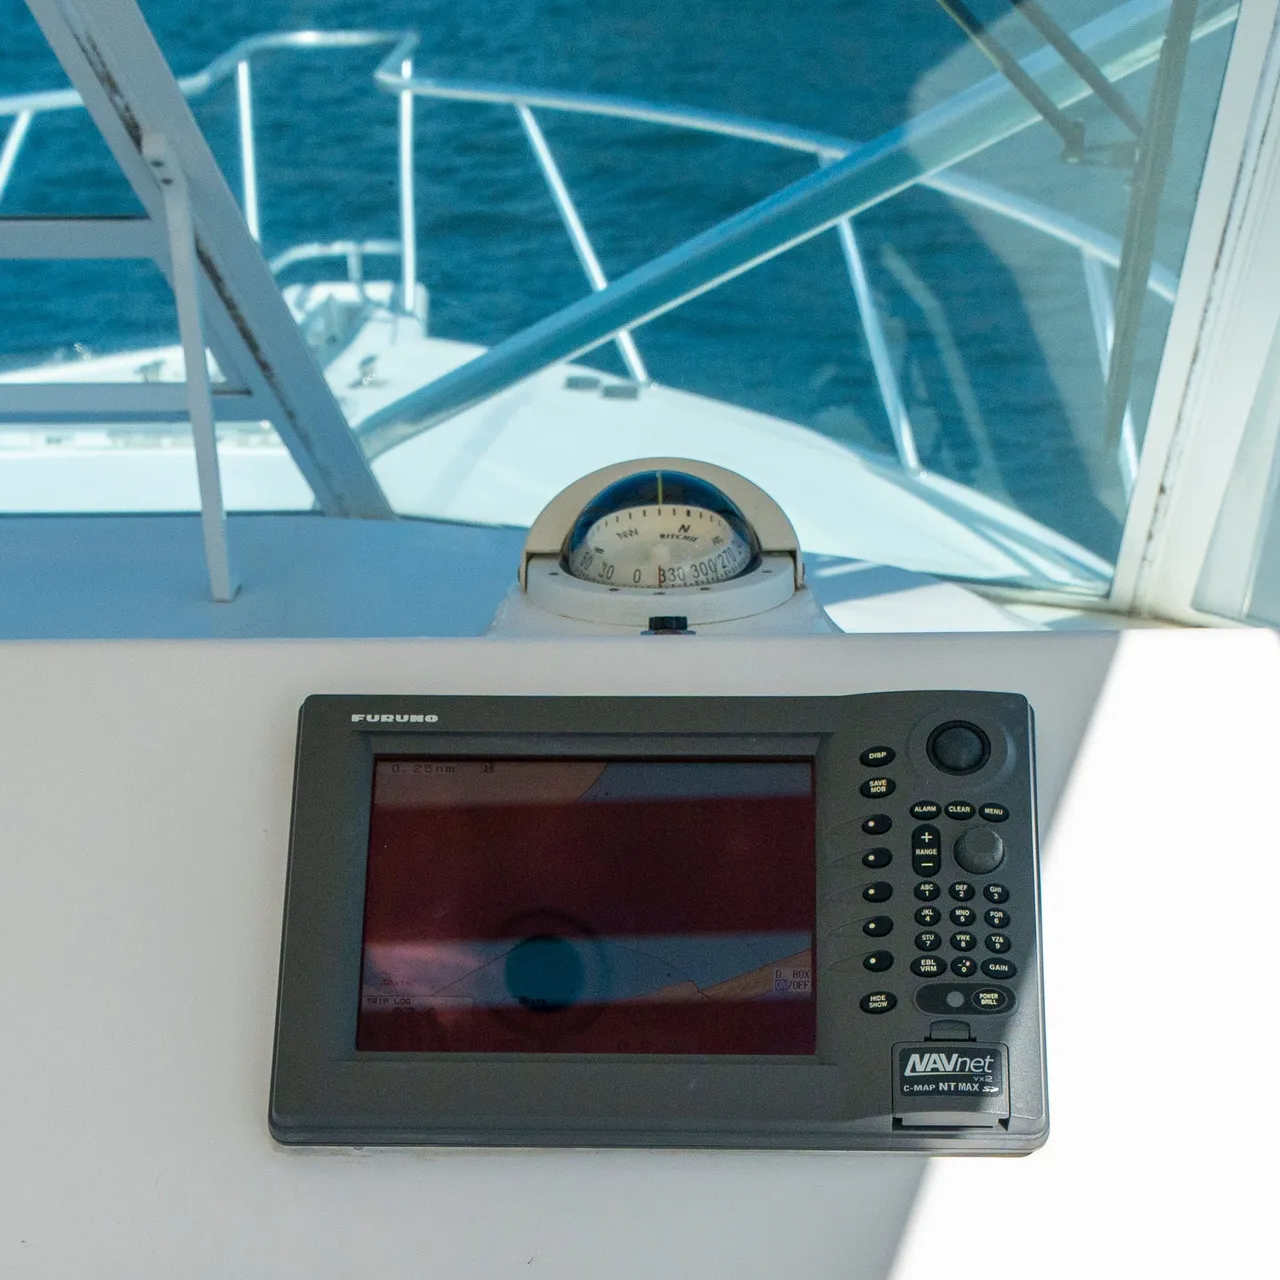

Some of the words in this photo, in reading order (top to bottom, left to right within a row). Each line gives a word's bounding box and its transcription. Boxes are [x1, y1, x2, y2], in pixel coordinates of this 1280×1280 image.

[678, 524, 691, 533] N
[616, 528, 639, 540] NW
[598, 562, 616, 581] 30
[692, 559, 718, 579] 300
[632, 569, 642, 584] 0
[660, 567, 686, 584] 330
[351, 714, 439, 723] FURUNO
[869, 779, 887, 787] SAVE
[989, 964, 1009, 972] GAIN
[775, 970, 782, 978] D
[792, 970, 810, 978] BOX
[393, 998, 411, 1006] LOG
[904, 1053, 995, 1076] NAVnet
[903, 1084, 936, 1092] C-MAP
[939, 1082, 957, 1091] NT
[958, 1083, 980, 1092] MAX
